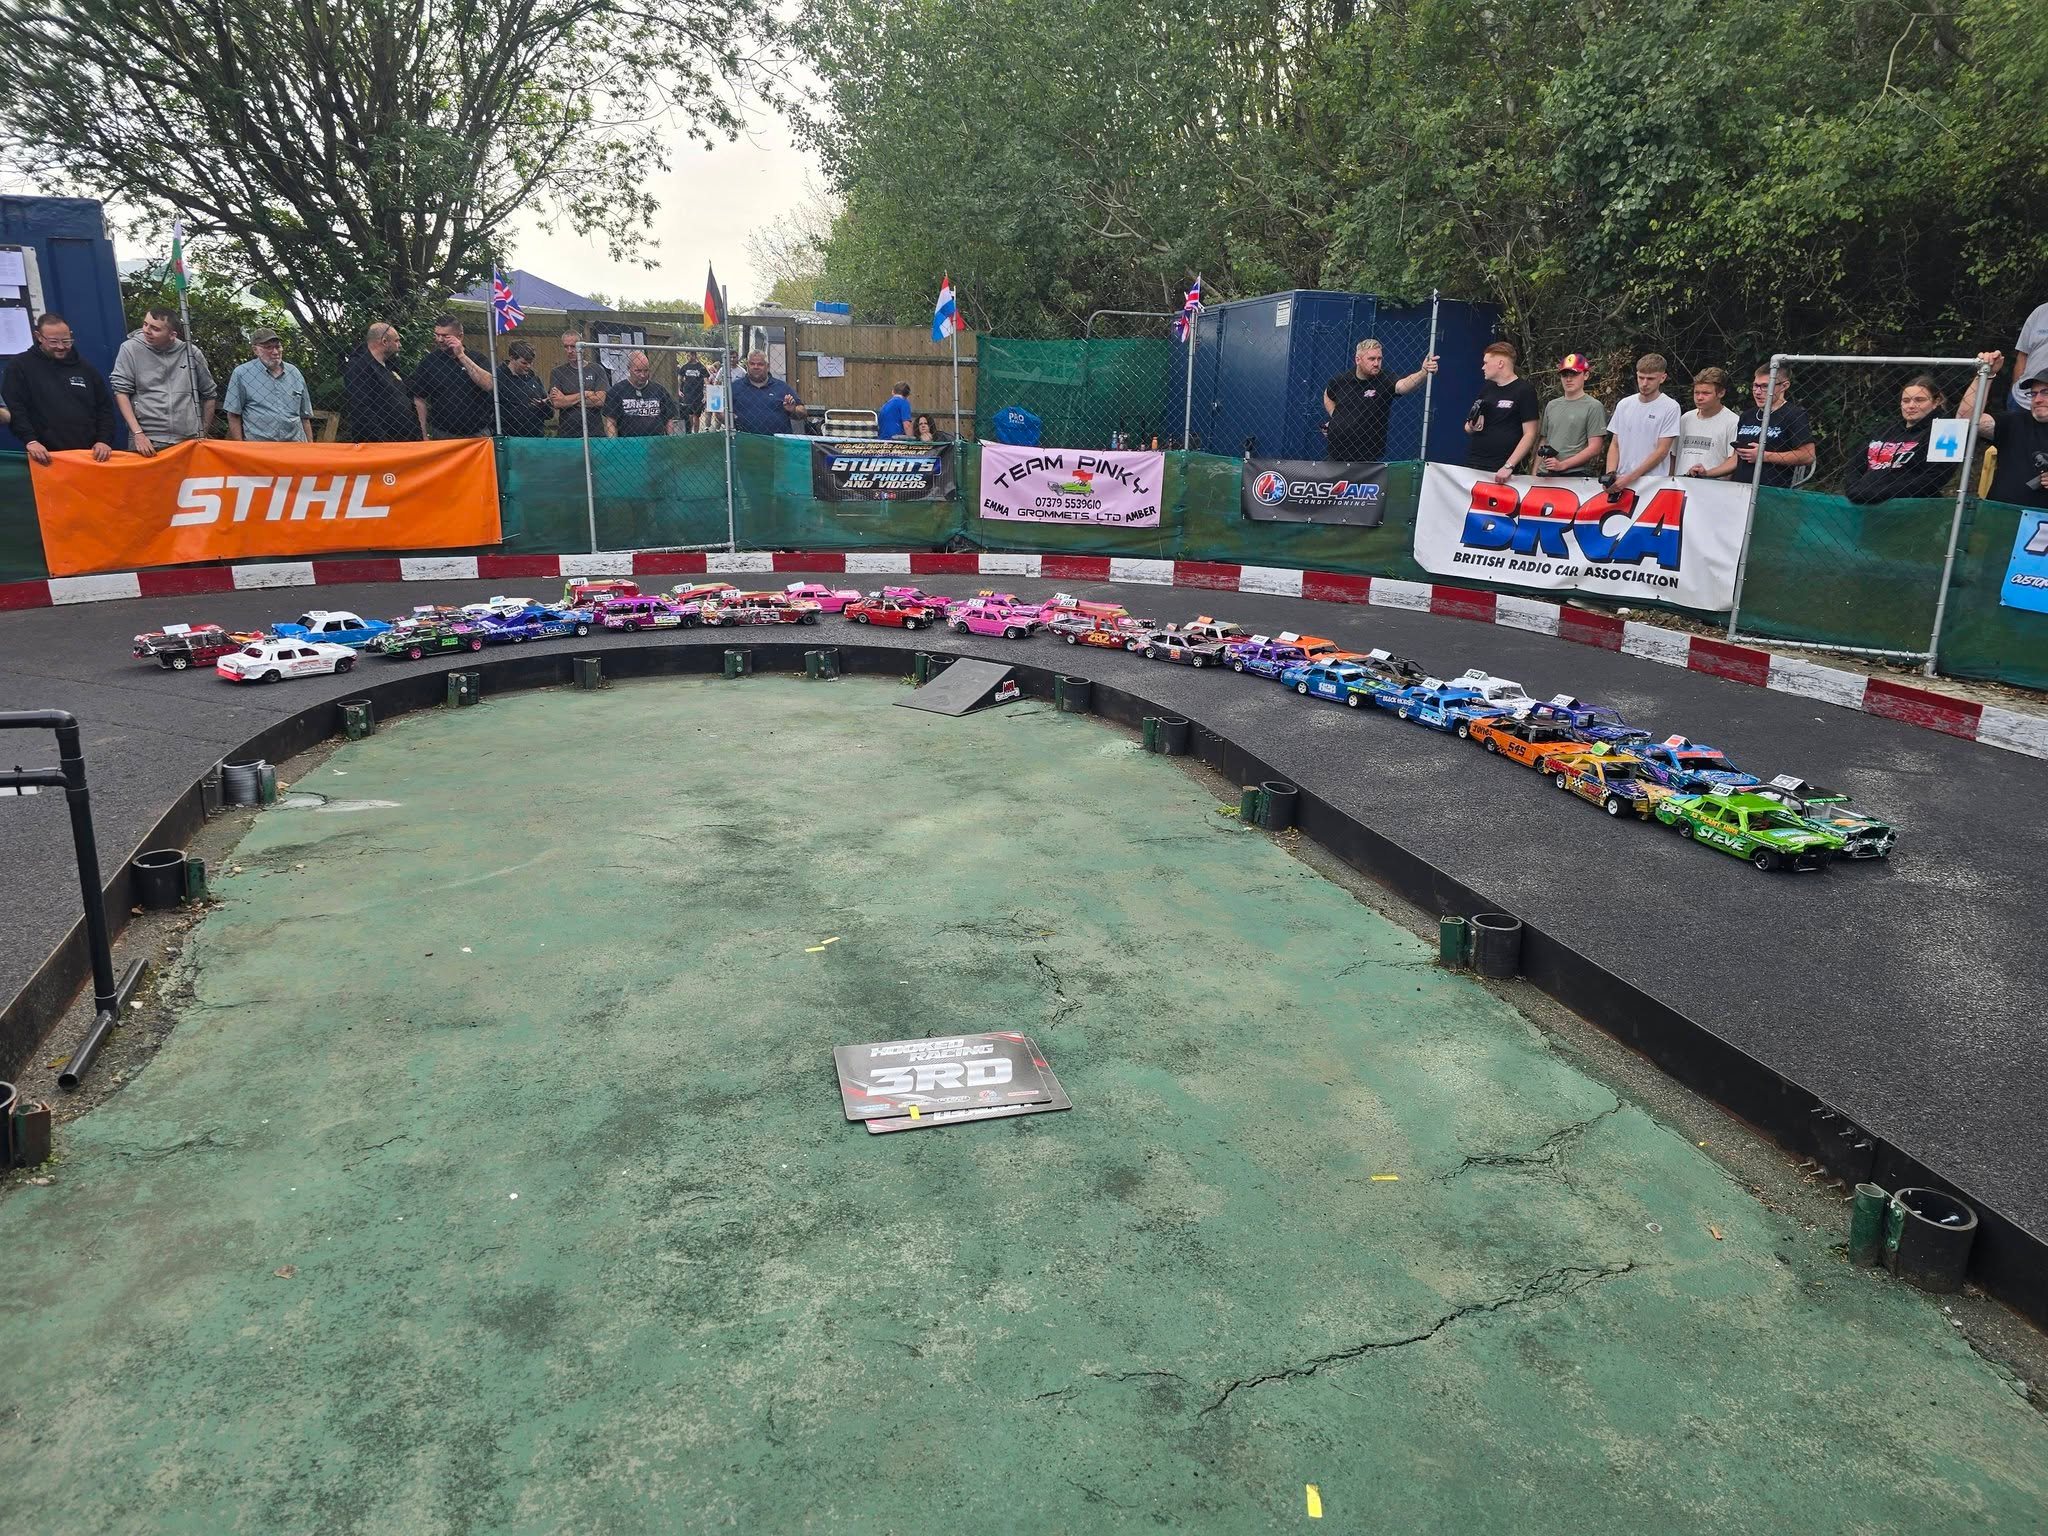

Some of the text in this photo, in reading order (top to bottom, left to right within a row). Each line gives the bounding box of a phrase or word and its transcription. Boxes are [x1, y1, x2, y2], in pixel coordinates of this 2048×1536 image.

[1935, 424, 1958, 457] 4
[842, 480, 927, 488] AND VIDEOS
[872, 473, 923, 481] PHOTOS
[994, 455, 1149, 495] TEAM PINKY
[1288, 480, 1380, 500] GAS4AIR
[170, 474, 390, 527] STIHL
[984, 499, 1009, 516] EMMA
[1035, 497, 1102, 510] 07379 5539610
[1017, 508, 1121, 522] GROMMETS LTD
[1125, 505, 1157, 523] AMBER
[1460, 480, 1687, 572] BRCA
[1453, 551, 1679, 589] BRITISH RADIO CAR ASSOCIATION
[1696, 824, 1748, 851] STEVE
[870, 1039, 965, 1057] HOOKED
[909, 1044, 994, 1062] RACING
[866, 1058, 1013, 1097] 3RD
